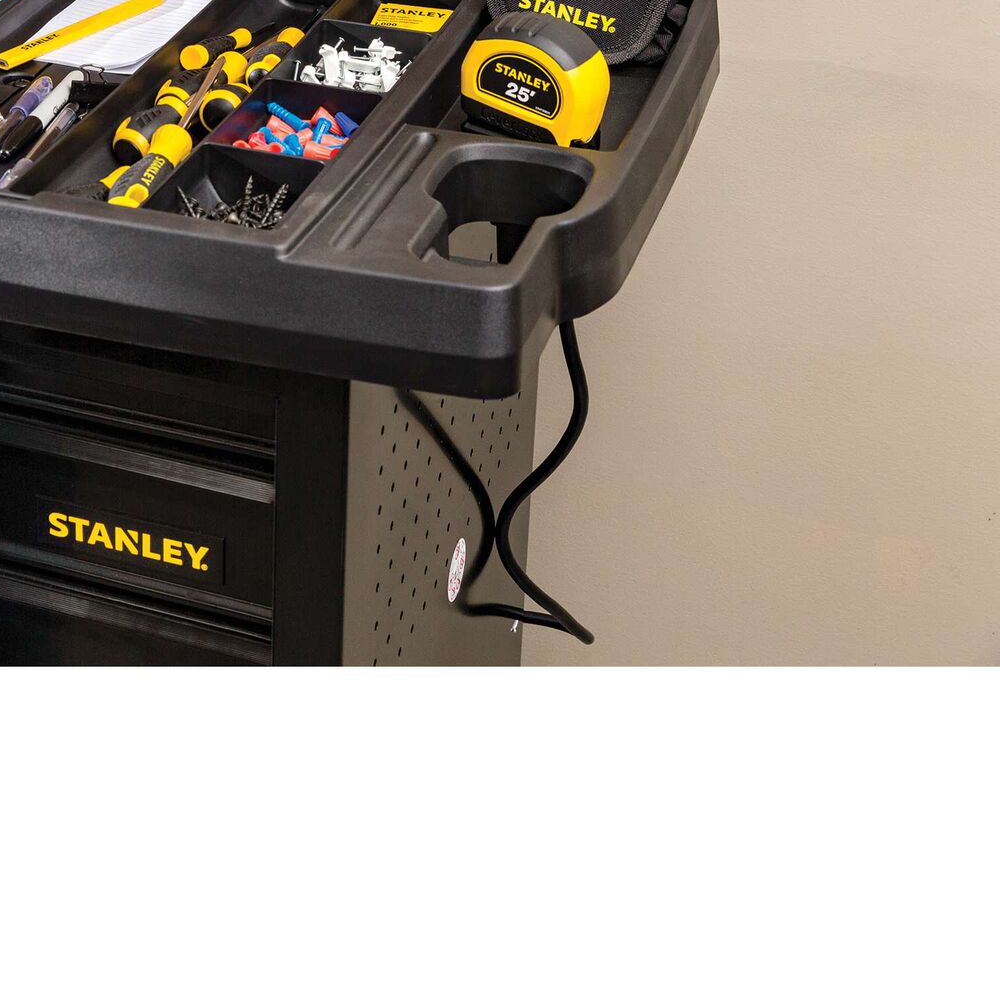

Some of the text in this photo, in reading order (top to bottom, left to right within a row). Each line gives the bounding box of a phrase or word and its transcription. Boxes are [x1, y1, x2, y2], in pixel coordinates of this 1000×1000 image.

[380, 7, 446, 18] STANLEY
[20, 33, 60, 51] STANLEY
[494, 62, 551, 92] STANLEY
[140, 156, 166, 186] STANLEY
[48, 512, 210, 572] STANLEY
